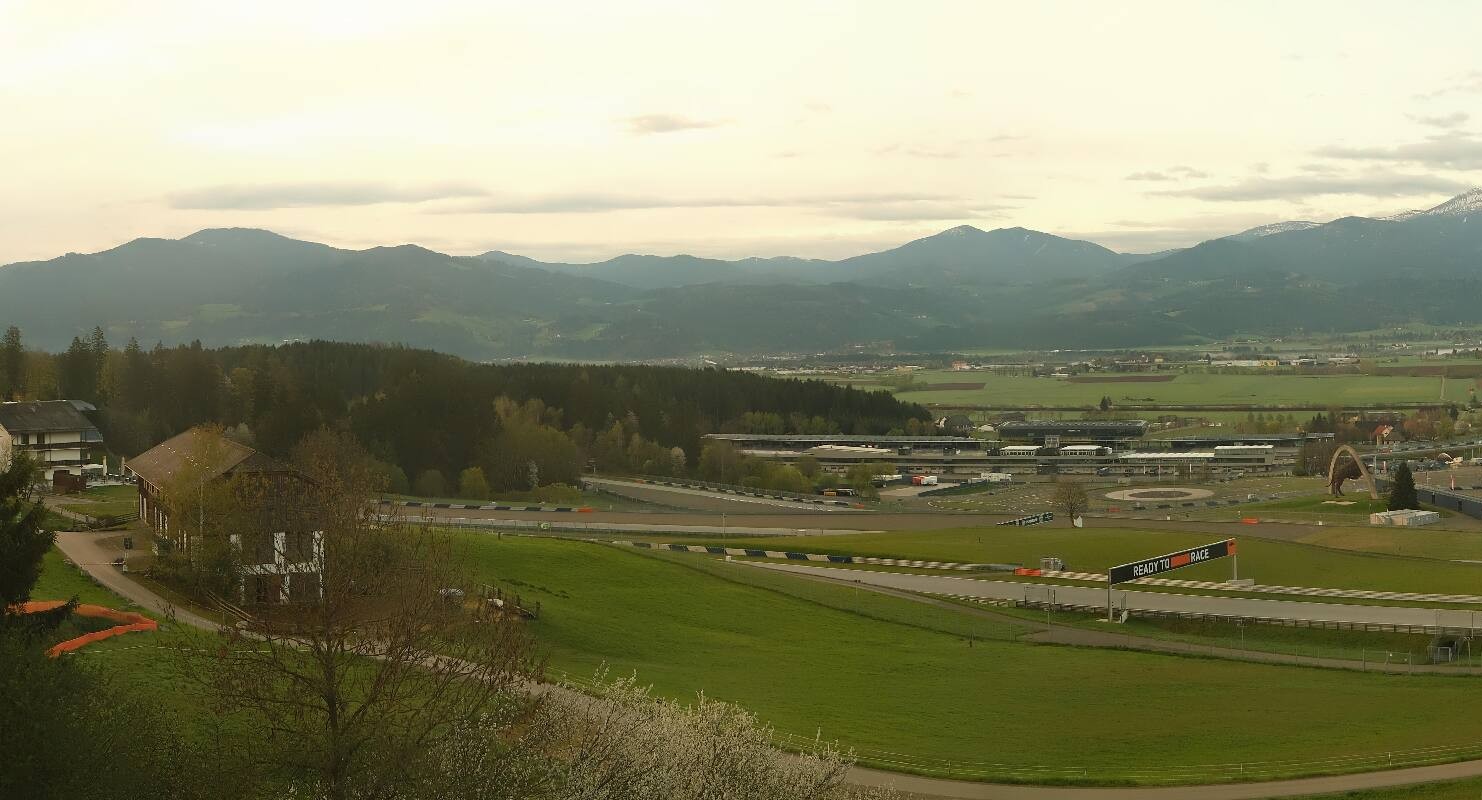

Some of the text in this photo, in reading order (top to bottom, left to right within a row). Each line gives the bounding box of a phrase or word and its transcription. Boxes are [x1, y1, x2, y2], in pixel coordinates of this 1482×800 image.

[1133, 549, 1209, 576] READY TO RACE
